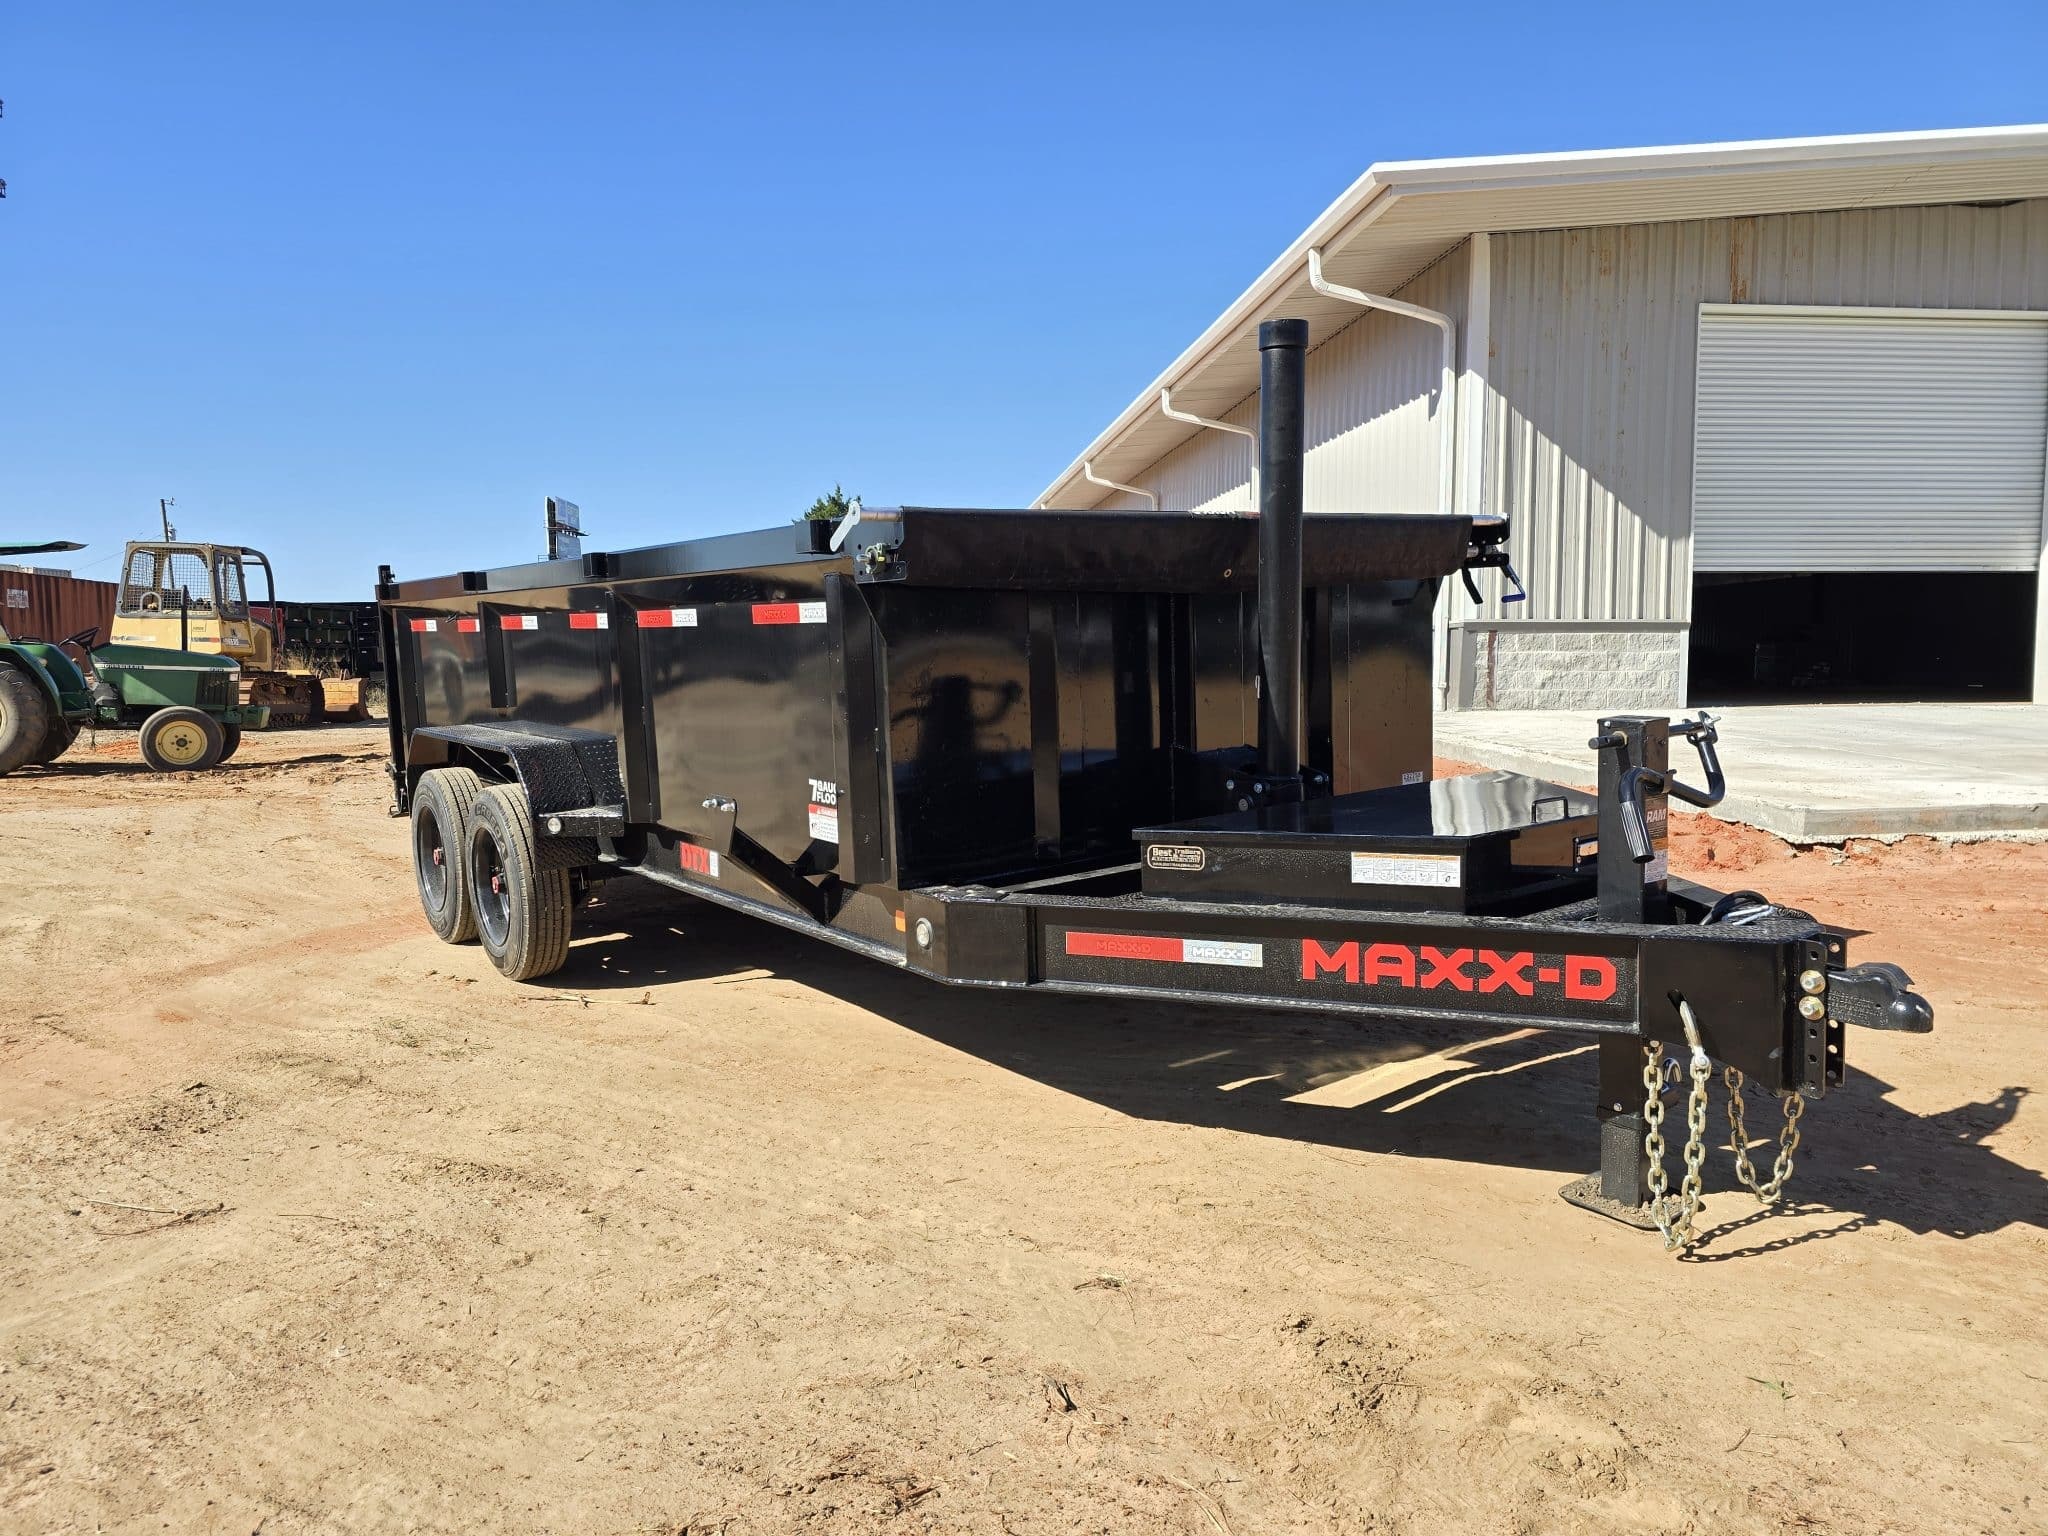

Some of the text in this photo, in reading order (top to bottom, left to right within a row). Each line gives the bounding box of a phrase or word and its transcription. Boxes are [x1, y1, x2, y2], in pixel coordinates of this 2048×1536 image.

[808, 778, 818, 802] 7
[816, 791, 837, 805] FLOO
[1646, 808, 1667, 824] RAM
[681, 841, 710, 875] DTX
[1152, 847, 1173, 857] Best
[1192, 945, 1252, 961] MAXX-D
[1302, 938, 1617, 1001] MAXX-D
